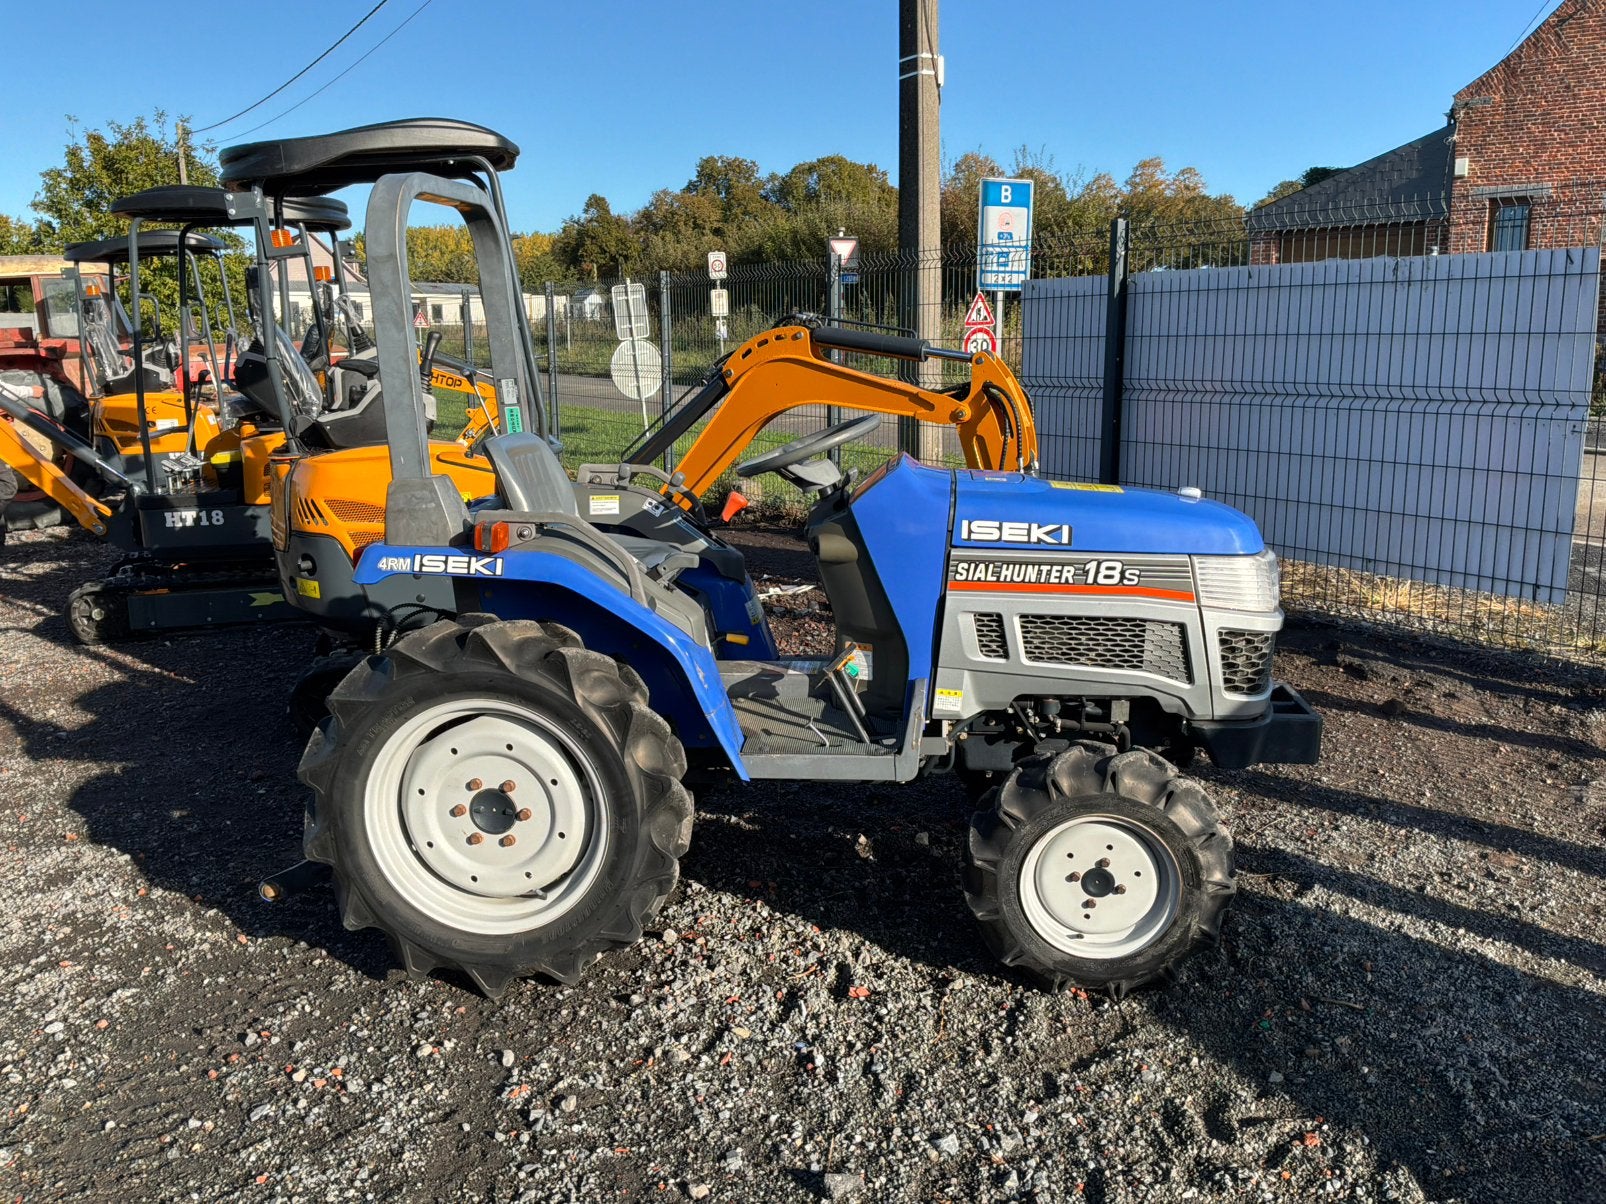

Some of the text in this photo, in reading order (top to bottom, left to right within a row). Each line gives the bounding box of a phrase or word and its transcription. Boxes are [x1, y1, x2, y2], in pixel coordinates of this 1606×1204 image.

[1000, 185, 1012, 203] B
[970, 338, 989, 353] 30
[164, 510, 225, 527] HT18
[960, 519, 1072, 546] ISEKI
[378, 553, 504, 576] 4RM ISEKI
[954, 561, 998, 582] SIAL
[998, 562, 1076, 584] HUNTER
